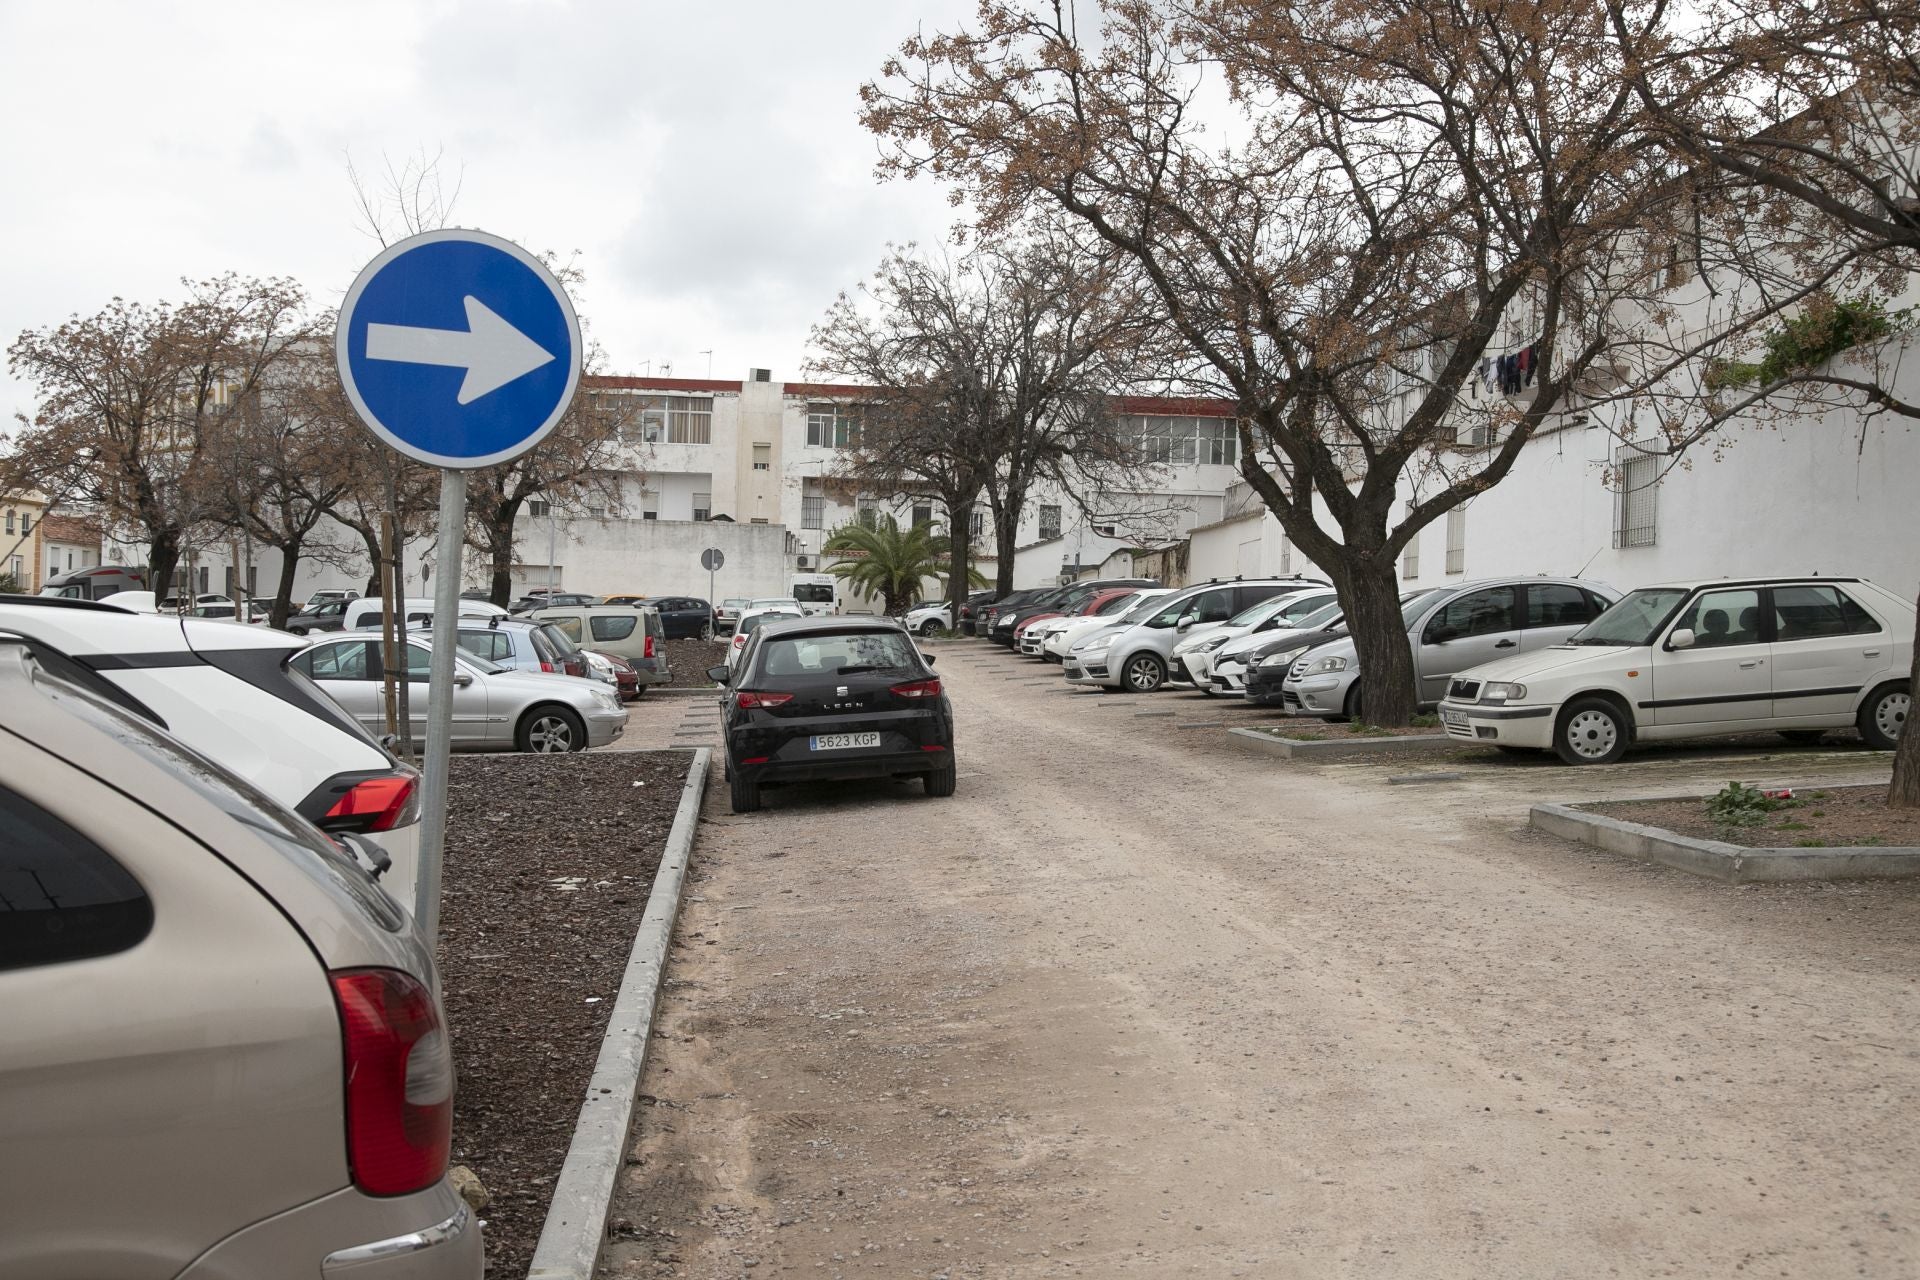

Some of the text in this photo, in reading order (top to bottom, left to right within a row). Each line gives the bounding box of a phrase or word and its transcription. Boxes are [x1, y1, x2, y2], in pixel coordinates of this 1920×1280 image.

[823, 702, 863, 710] LEON
[818, 733, 877, 749] 5623 KGP
